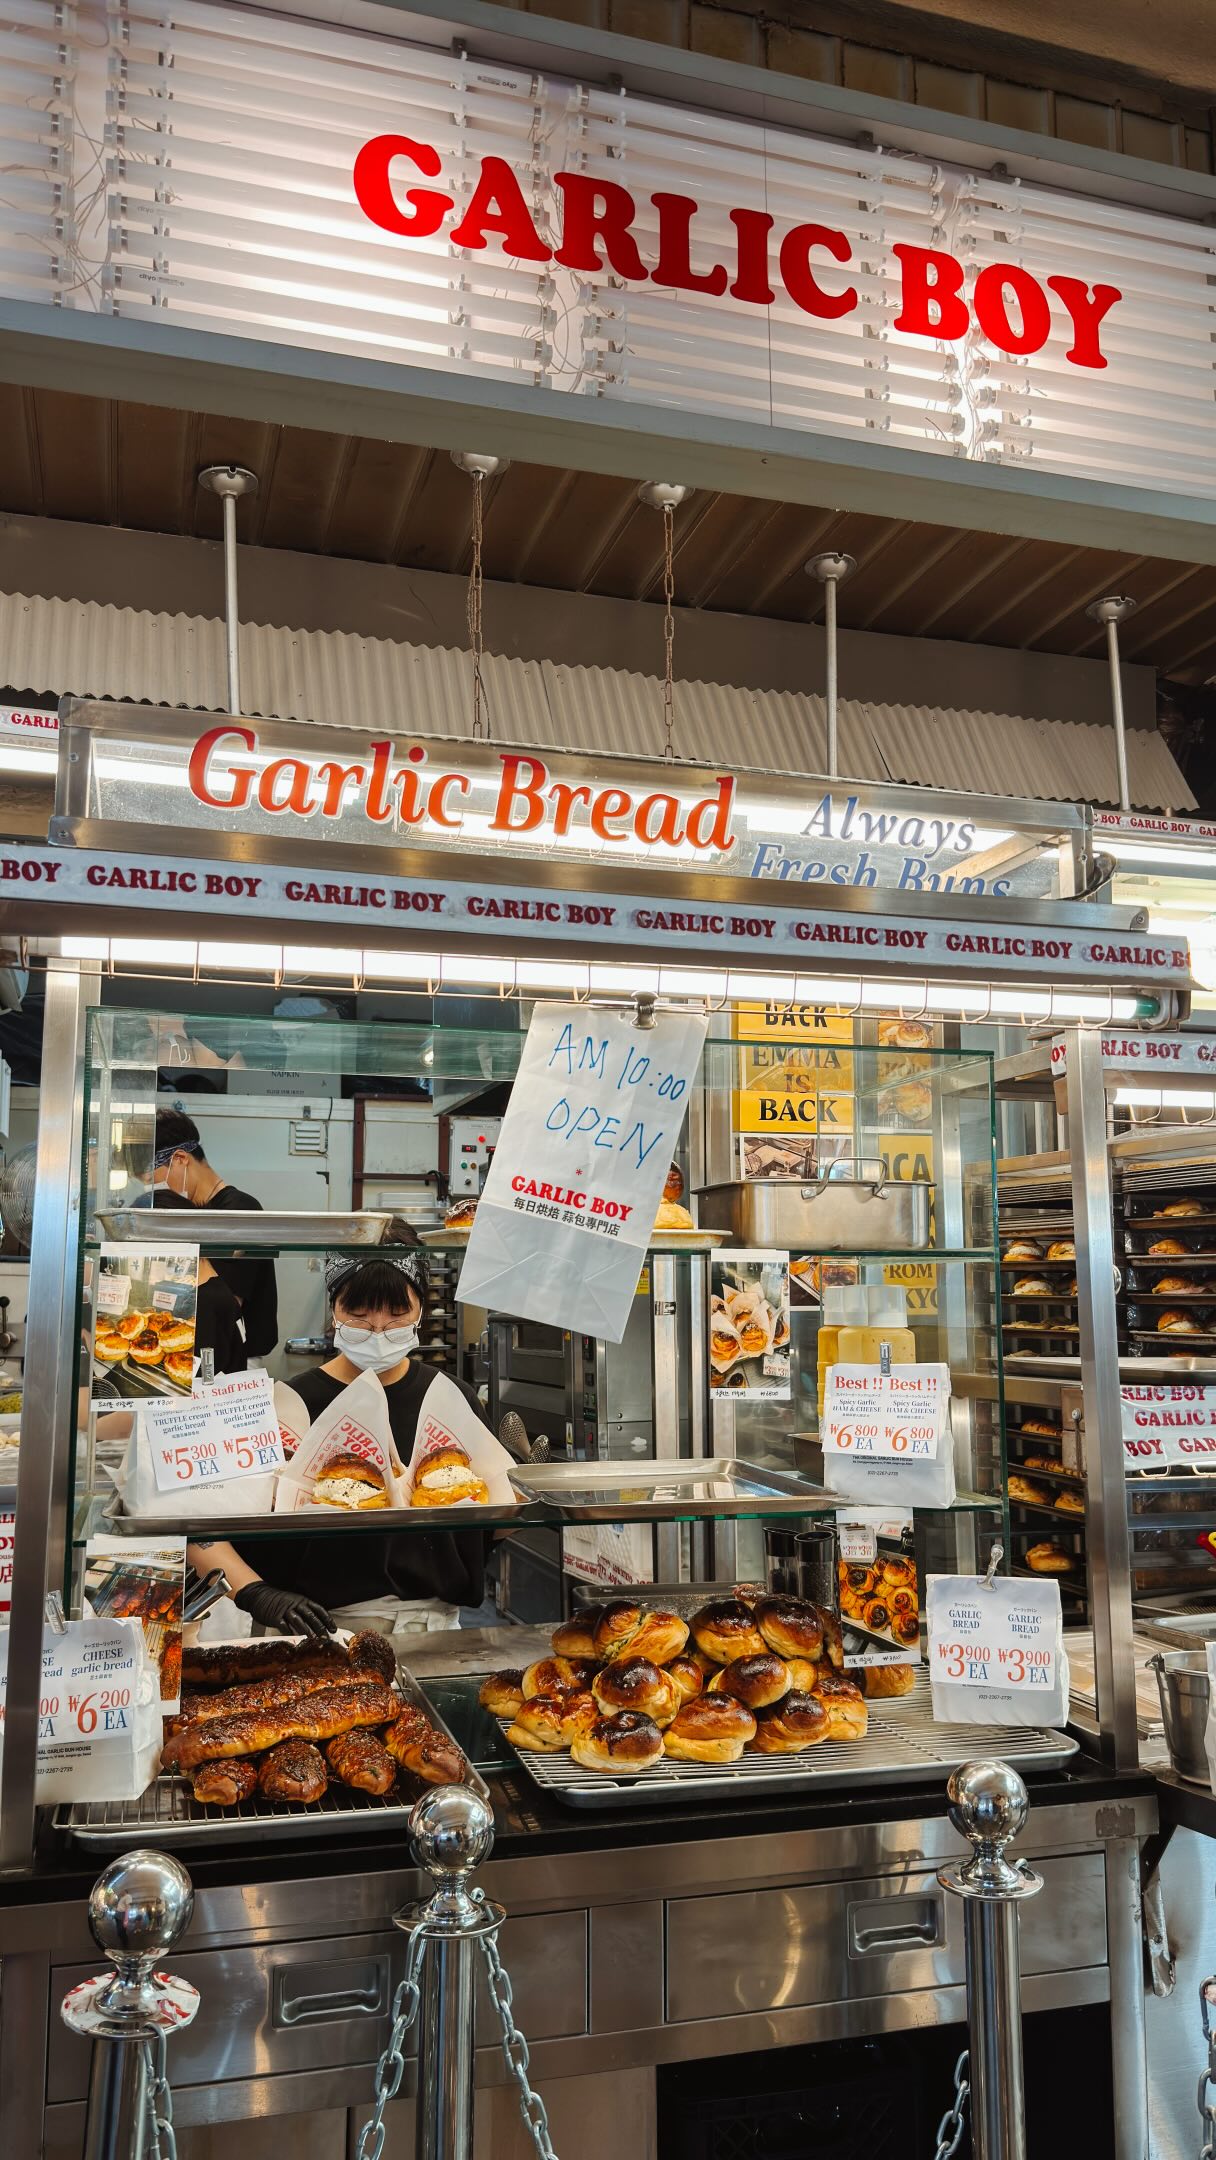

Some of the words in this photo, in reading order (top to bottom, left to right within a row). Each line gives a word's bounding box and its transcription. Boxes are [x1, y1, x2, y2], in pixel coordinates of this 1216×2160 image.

[354, 134, 858, 319] GARLIC
[893, 244, 1123, 369] BOY
[188, 726, 471, 828] Garlic
[488, 754, 738, 851] Bread
[801, 794, 976, 859] Always
[1101, 814, 1121, 825] BOY
[1130, 817, 1168, 830] GARLIC
[1170, 822, 1191, 833] BOY
[751, 843, 877, 887] Fresh
[899, 857, 1011, 896] Buns
[0, 859, 61, 882] BOY
[87, 865, 197, 892] GARLIC
[205, 874, 262, 897] BOY
[285, 881, 386, 908] GARLIC
[394, 890, 446, 912] BOY
[467, 896, 561, 922] GARLIC
[568, 904, 616, 926] BOY
[636, 910, 723, 934] GARLIC
[730, 917, 776, 938] BOY
[795, 922, 879, 946] GARLIC
[884, 928, 928, 949] BOY
[946, 933, 1025, 957] GARLIC
[1032, 940, 1073, 960] BOY
[1090, 944, 1166, 966] GARLIC
[766, 1003, 828, 1028] BACK
[752, 1047, 841, 1070] EMMA
[1145, 1042, 1183, 1060] BOY
[548, 1023, 609, 1079] AM
[617, 1046, 686, 1101] 10:00
[758, 1098, 839, 1123] BACK
[546, 1097, 664, 1170] OPEN
[511, 1175, 587, 1209] GARLIC
[590, 1197, 633, 1221] BOY
[513, 1196, 560, 1220] 每日烘焙
[211, 1383, 235, 1397] Staff
[237, 1380, 259, 1392] Pick
[835, 1375, 868, 1390] Best
[889, 1378, 923, 1391] Best
[1171, 1385, 1207, 1401] BOY
[215, 1404, 247, 1416] TRUFFLE
[248, 1400, 271, 1410] cream
[223, 1413, 245, 1425] garlic
[245, 1408, 266, 1420] bread
[154, 1415, 188, 1426] TRUFFLE
[188, 1411, 211, 1421] cream
[162, 1423, 184, 1434] garlic
[184, 1420, 206, 1431] bread
[1134, 1409, 1206, 1427] GARLIC
[855, 1437, 873, 1450] EA
[912, 1440, 930, 1454] EA
[1124, 1438, 1164, 1457] BOY
[255, 1447, 279, 1465] EA
[198, 1459, 220, 1476] EA
[948, 1609, 982, 1619] GARLIC
[1007, 1613, 1042, 1624] GARLIC
[952, 1619, 980, 1629] BREAD
[1011, 1624, 1040, 1634] BREAD
[82, 1648, 124, 1662] CHEESE
[71, 1662, 101, 1677] garlic
[103, 1657, 133, 1671] bread
[969, 1663, 988, 1679] EA
[1029, 1667, 1049, 1684] EA
[103, 1709, 128, 1731] EA
